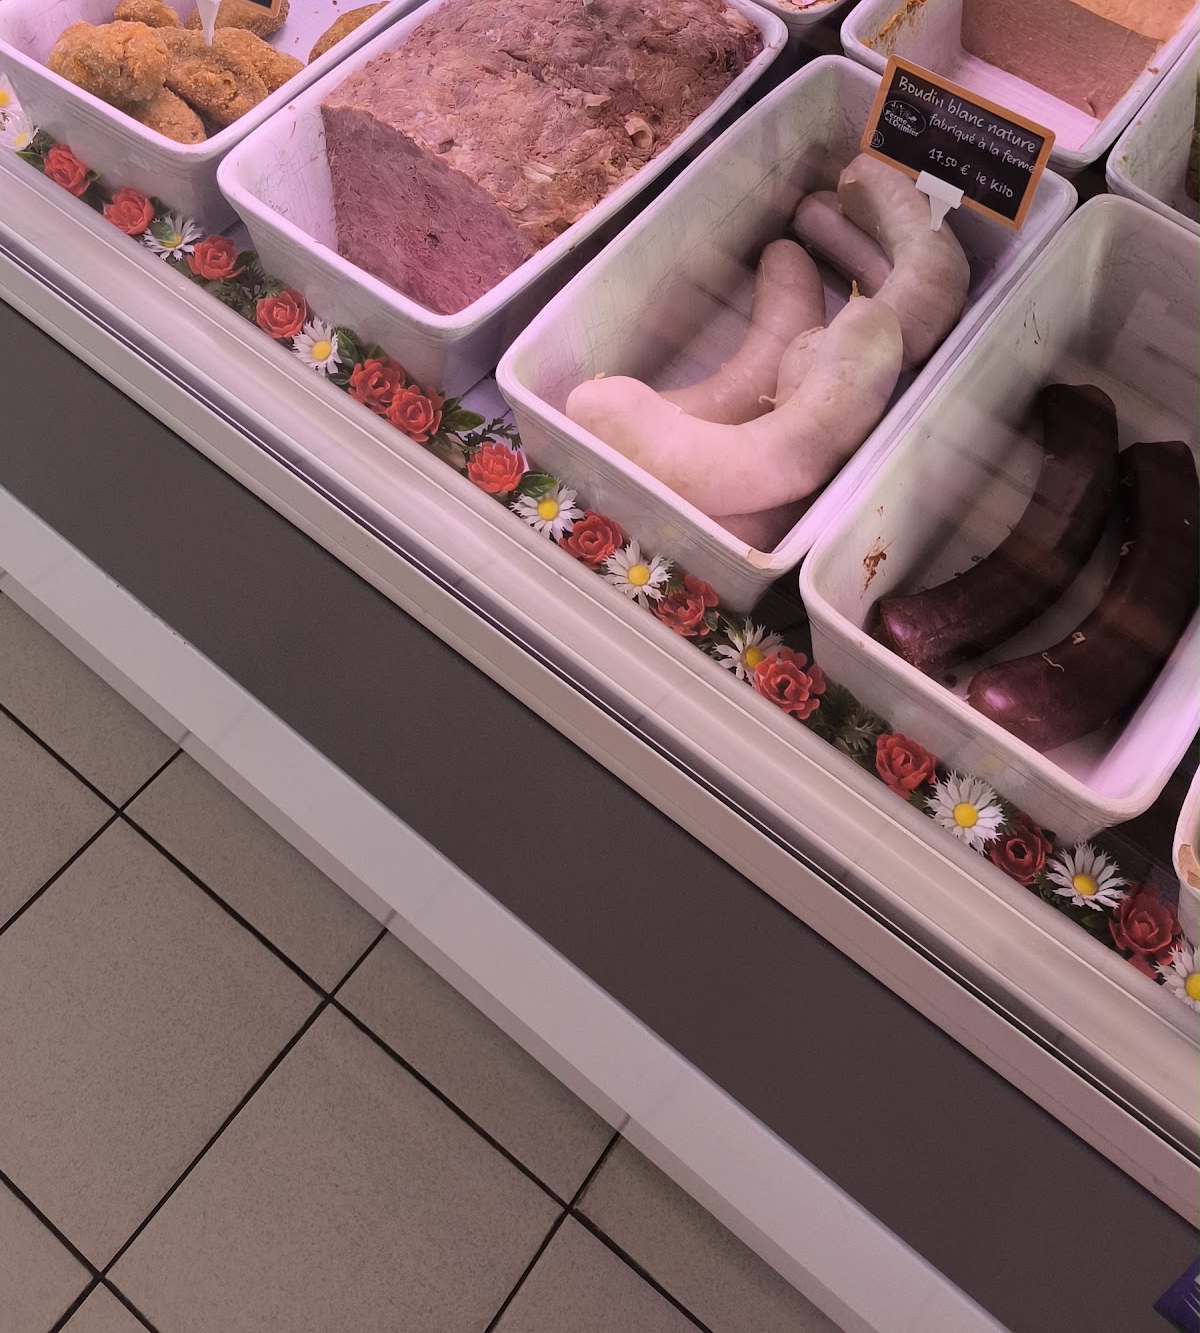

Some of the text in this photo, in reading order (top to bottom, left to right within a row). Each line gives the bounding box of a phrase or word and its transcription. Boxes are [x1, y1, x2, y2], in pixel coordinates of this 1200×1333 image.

[899, 75, 1036, 153] Boudin blanc nature
[929, 113, 1036, 174] fabriqué à la ferme
[928, 147, 958, 168] 17.50
[960, 164, 971, 176] €
[976, 172, 986, 185] le
